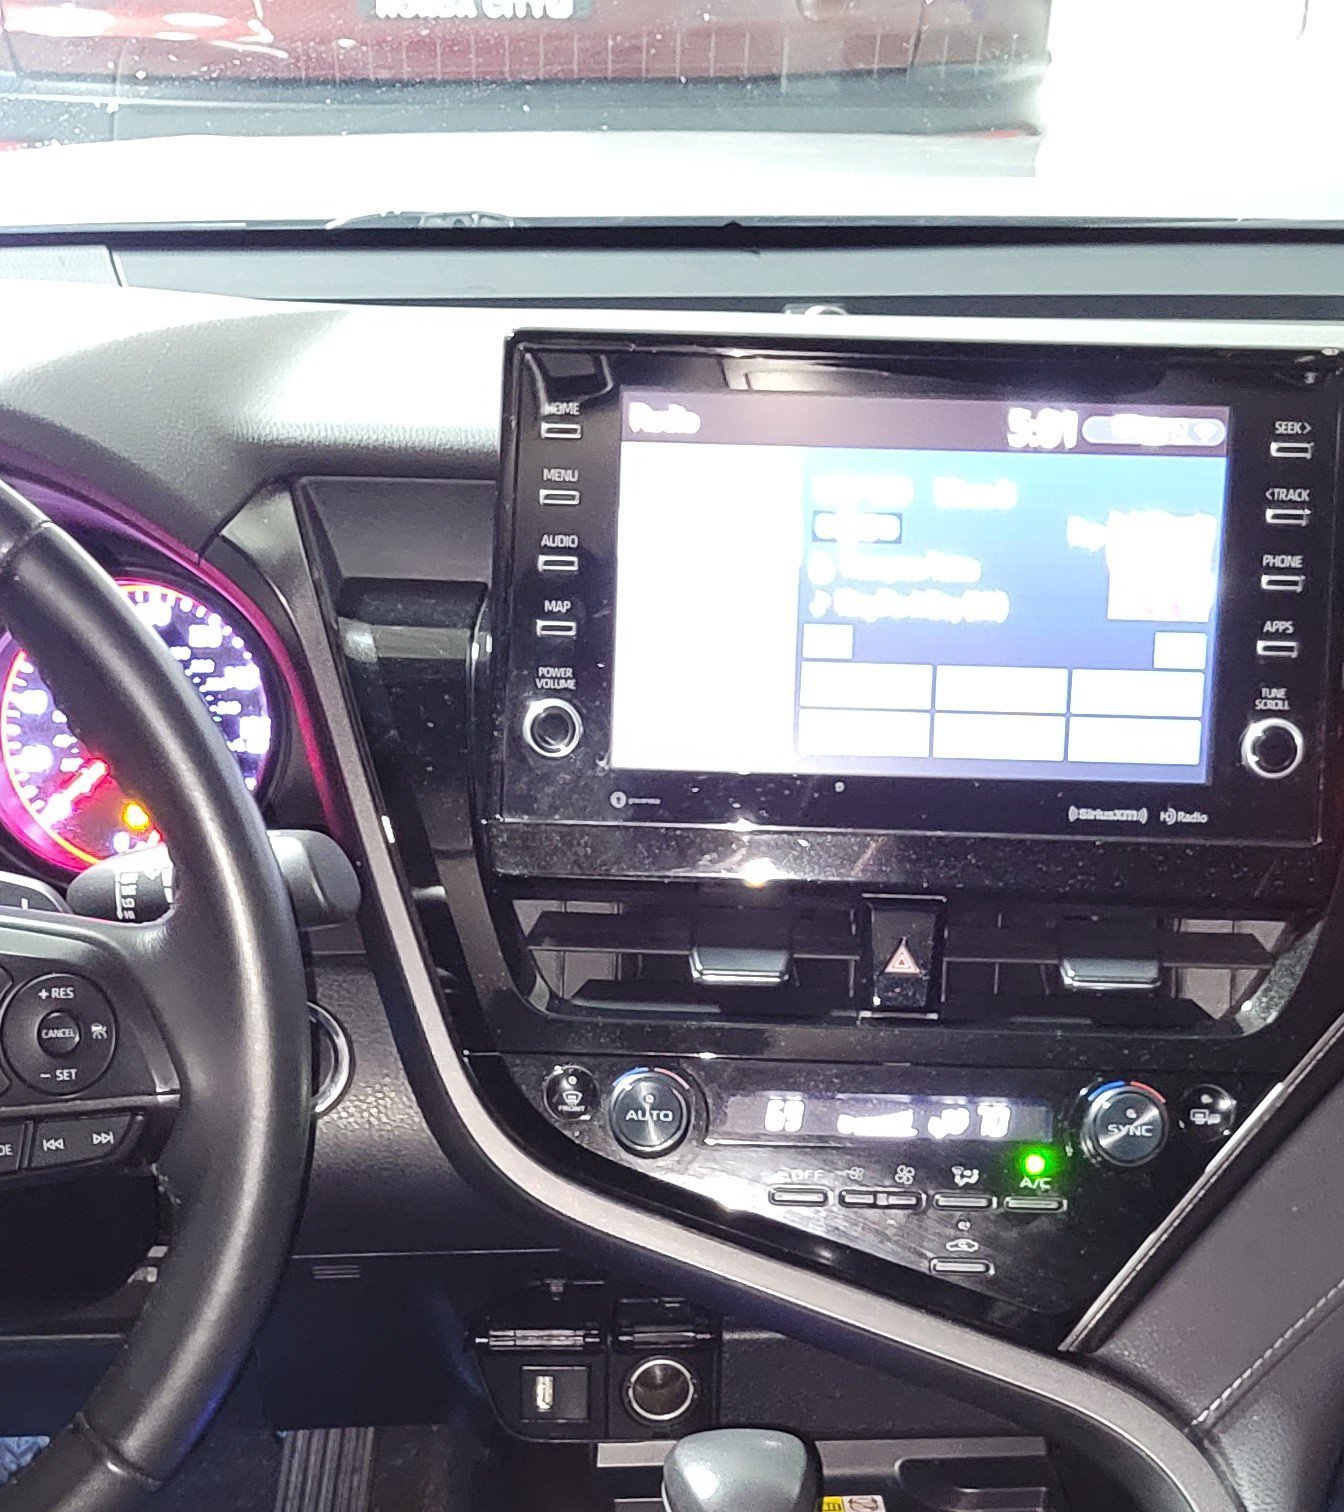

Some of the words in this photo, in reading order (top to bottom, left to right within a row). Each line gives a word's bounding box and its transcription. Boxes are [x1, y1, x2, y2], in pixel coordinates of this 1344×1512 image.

[542, 402, 580, 416] HOME
[542, 467, 579, 482] MENU
[540, 534, 579, 548] AUDIO
[1262, 554, 1304, 568] PHONE
[543, 599, 572, 613] MAP
[1262, 620, 1295, 634] APPS
[538, 667, 574, 678] POWER
[535, 678, 577, 690] VOLUME
[1260, 687, 1288, 699] TUNE
[1254, 699, 1291, 711] SCROLL
[1177, 811, 1209, 823] Radio
[55, 1068, 78, 1081] SET
[624, 1108, 674, 1122] AUTO
[1107, 1123, 1155, 1138] SYNC
[1019, 1176, 1053, 1191] A/C
